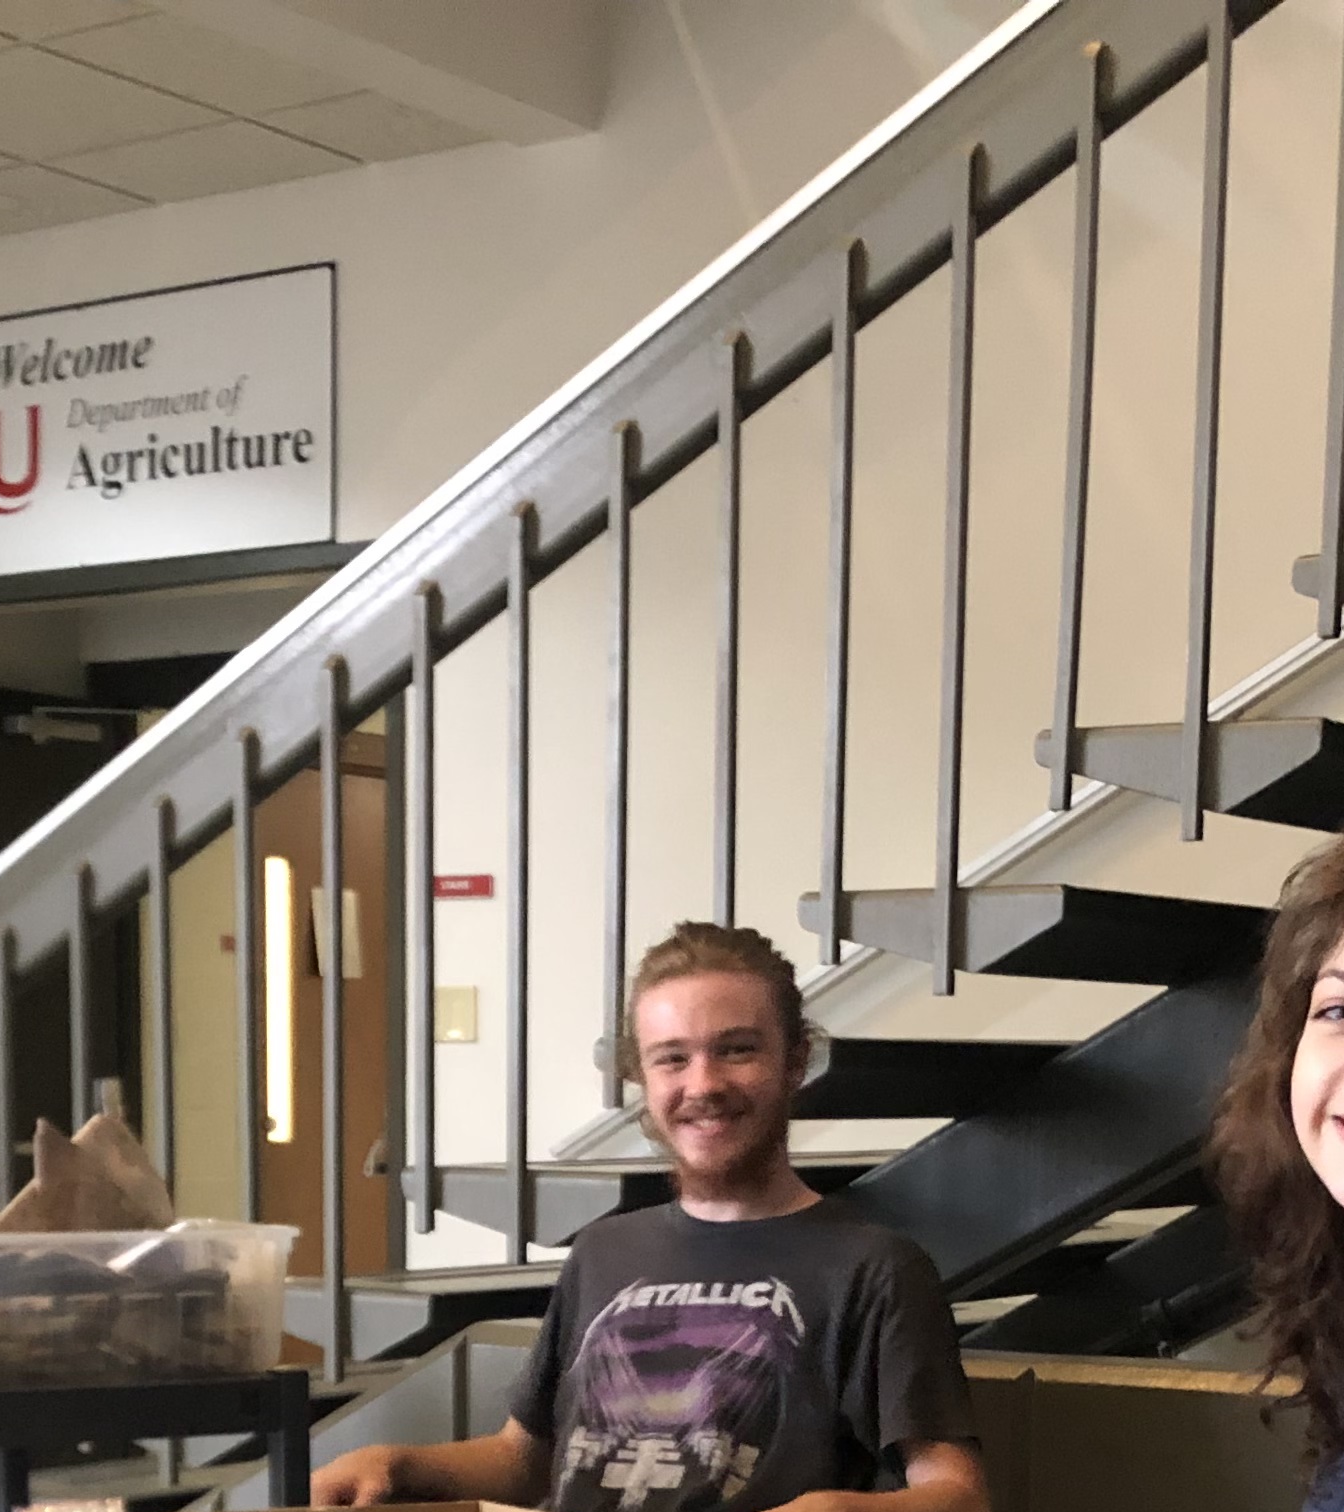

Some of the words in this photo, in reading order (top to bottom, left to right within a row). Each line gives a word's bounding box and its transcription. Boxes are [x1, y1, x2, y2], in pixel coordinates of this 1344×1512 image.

[66, 384, 209, 431] Department
[215, 374, 247, 413] of
[66, 423, 315, 500] Agriculture
[594, 1276, 806, 1346] METALLICA
